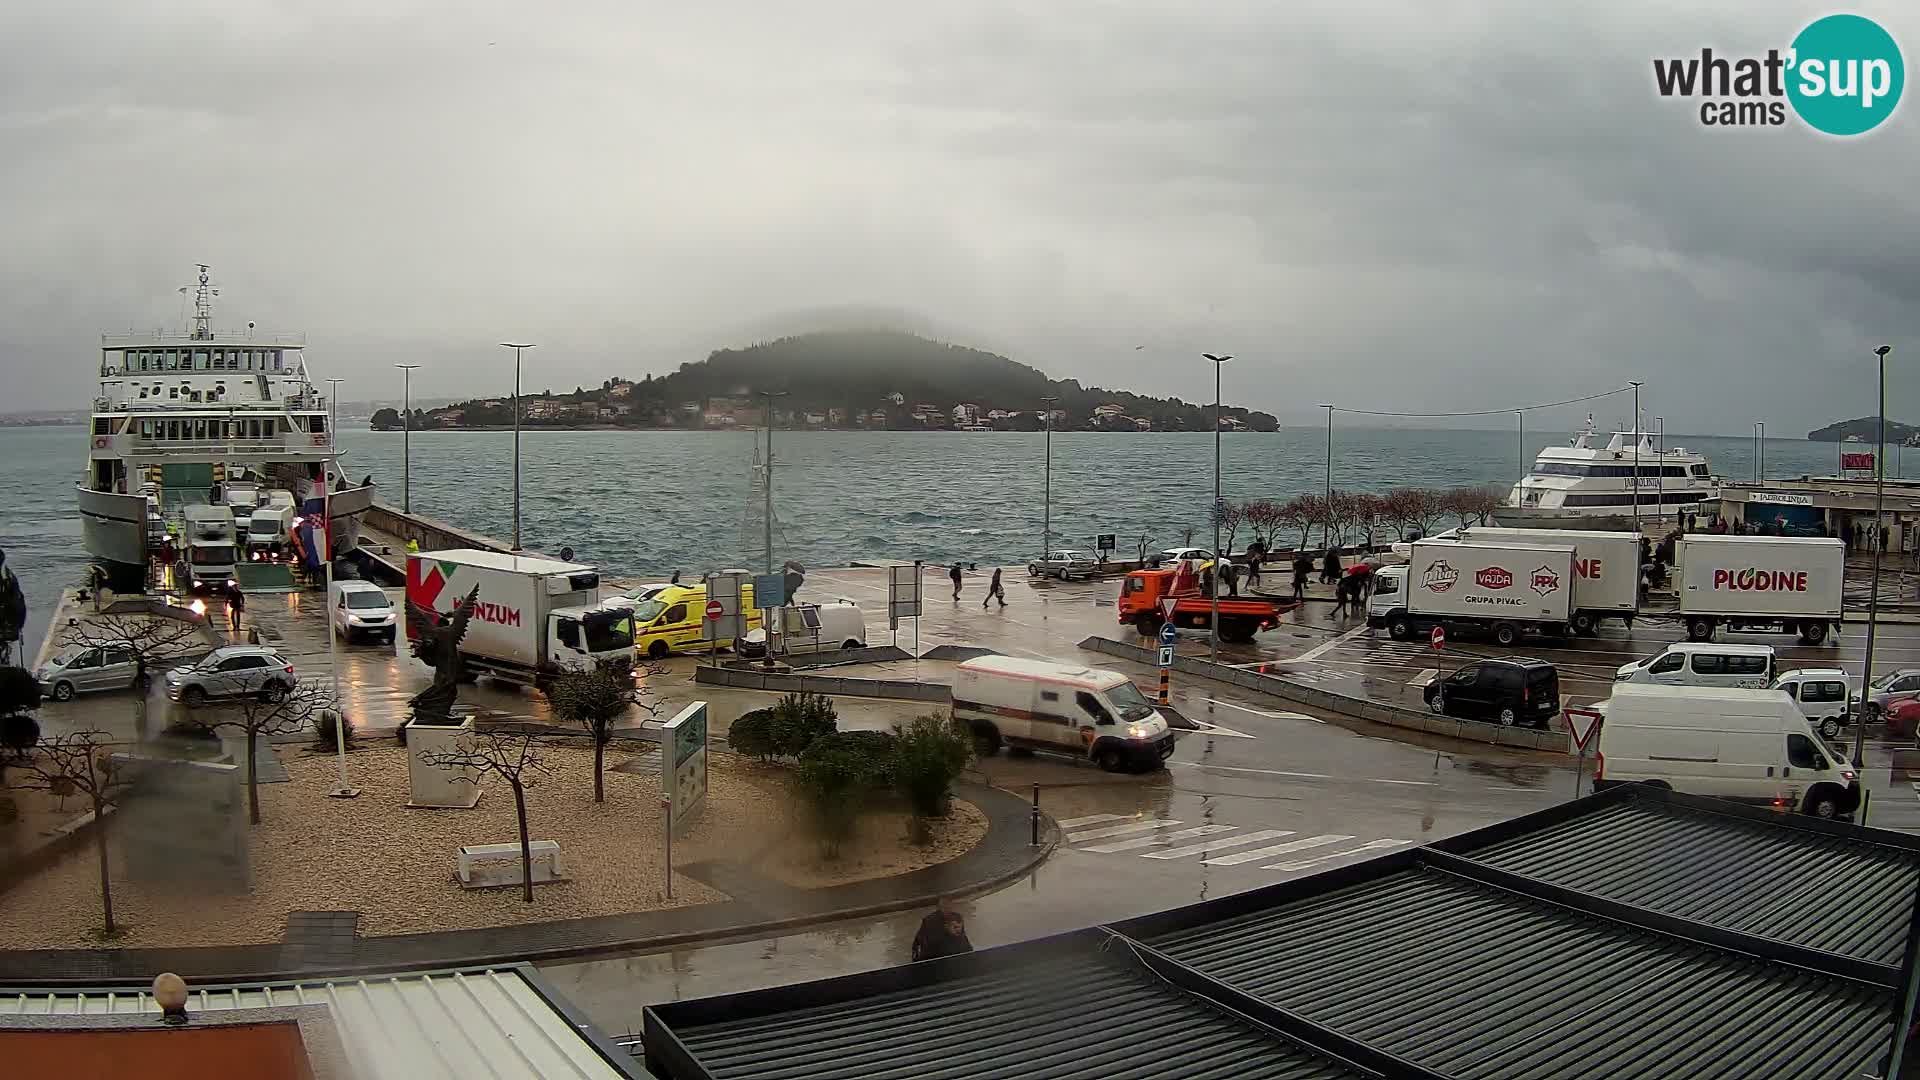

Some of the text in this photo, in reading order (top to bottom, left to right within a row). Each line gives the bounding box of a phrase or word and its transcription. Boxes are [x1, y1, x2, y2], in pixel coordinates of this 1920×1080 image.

[1478, 573, 1511, 585] VAJDA
[1714, 567, 1808, 592] PLODINE
[1465, 595, 1522, 606] GRUPA PIVAC
